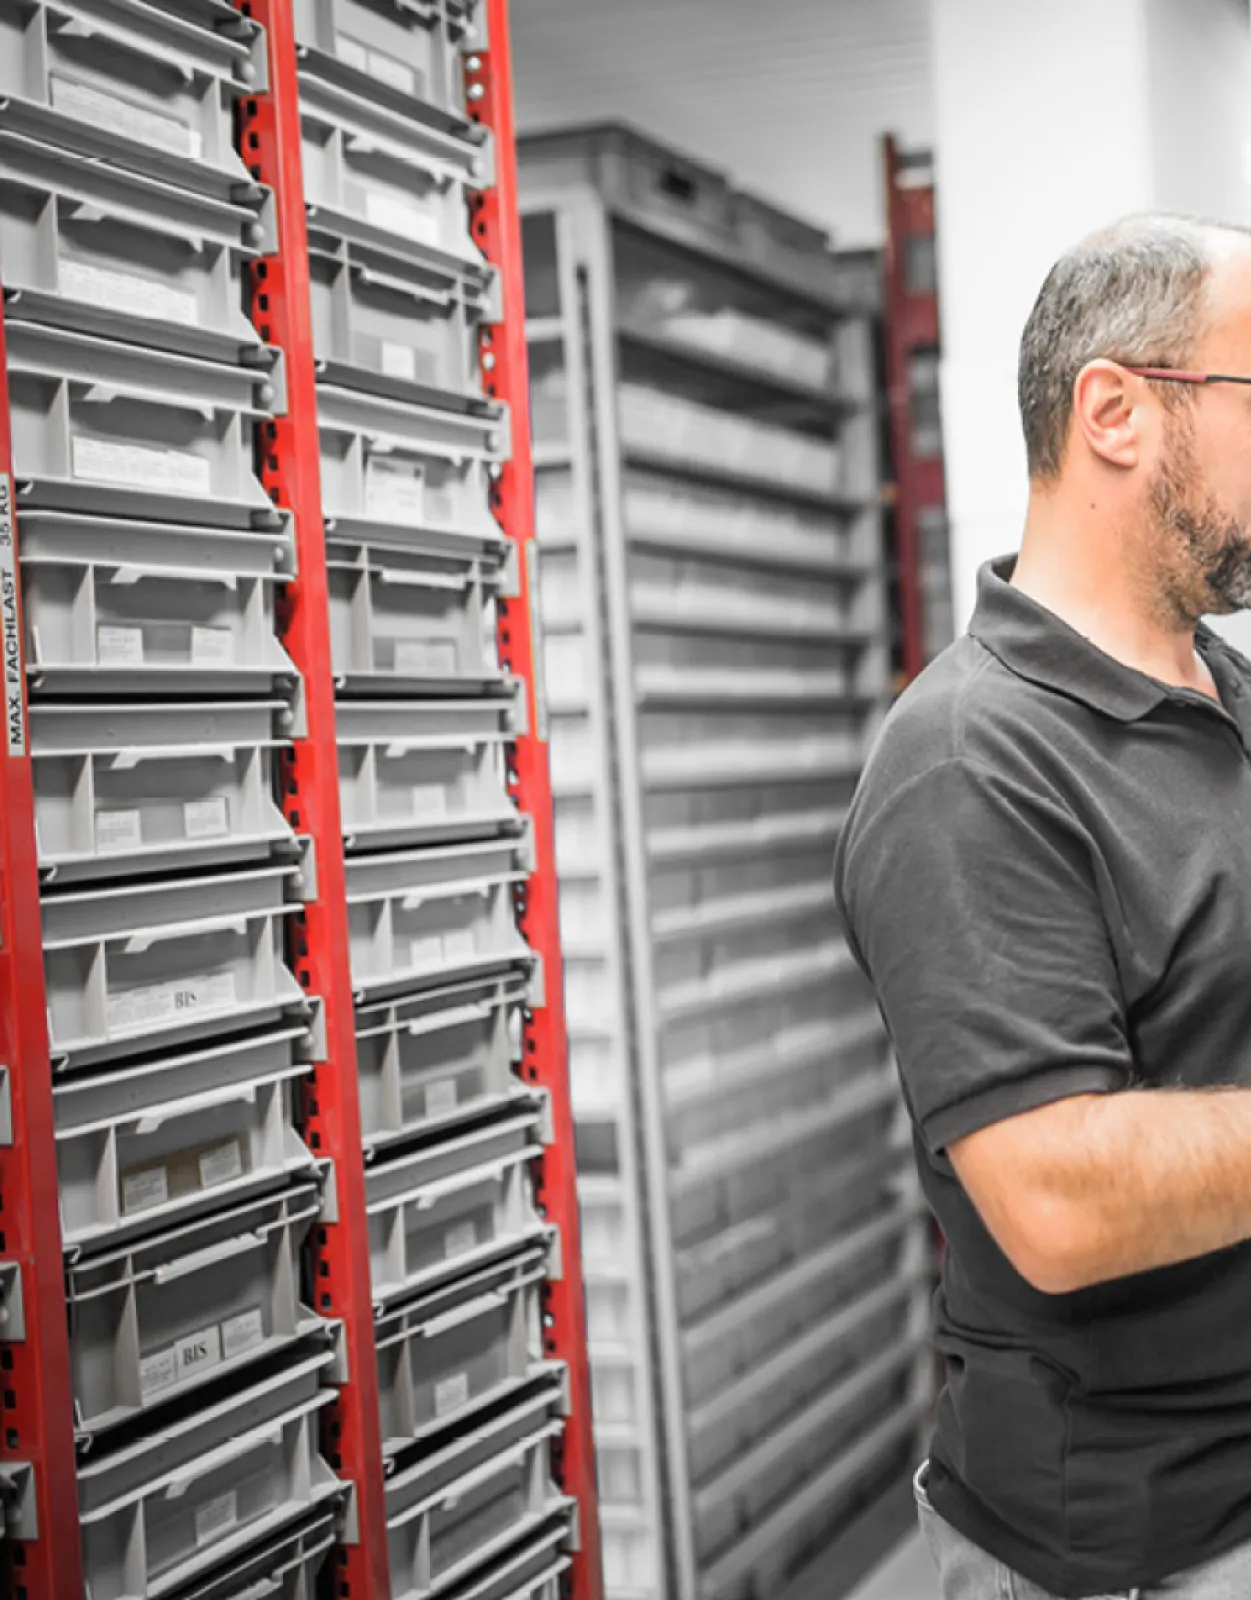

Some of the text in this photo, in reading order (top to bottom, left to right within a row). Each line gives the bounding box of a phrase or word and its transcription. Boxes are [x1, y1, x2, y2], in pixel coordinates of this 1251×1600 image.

[2, 570, 19, 683] FACHLAST
[9, 690, 21, 745] MAX.
[182, 1341, 208, 1366] BIS
